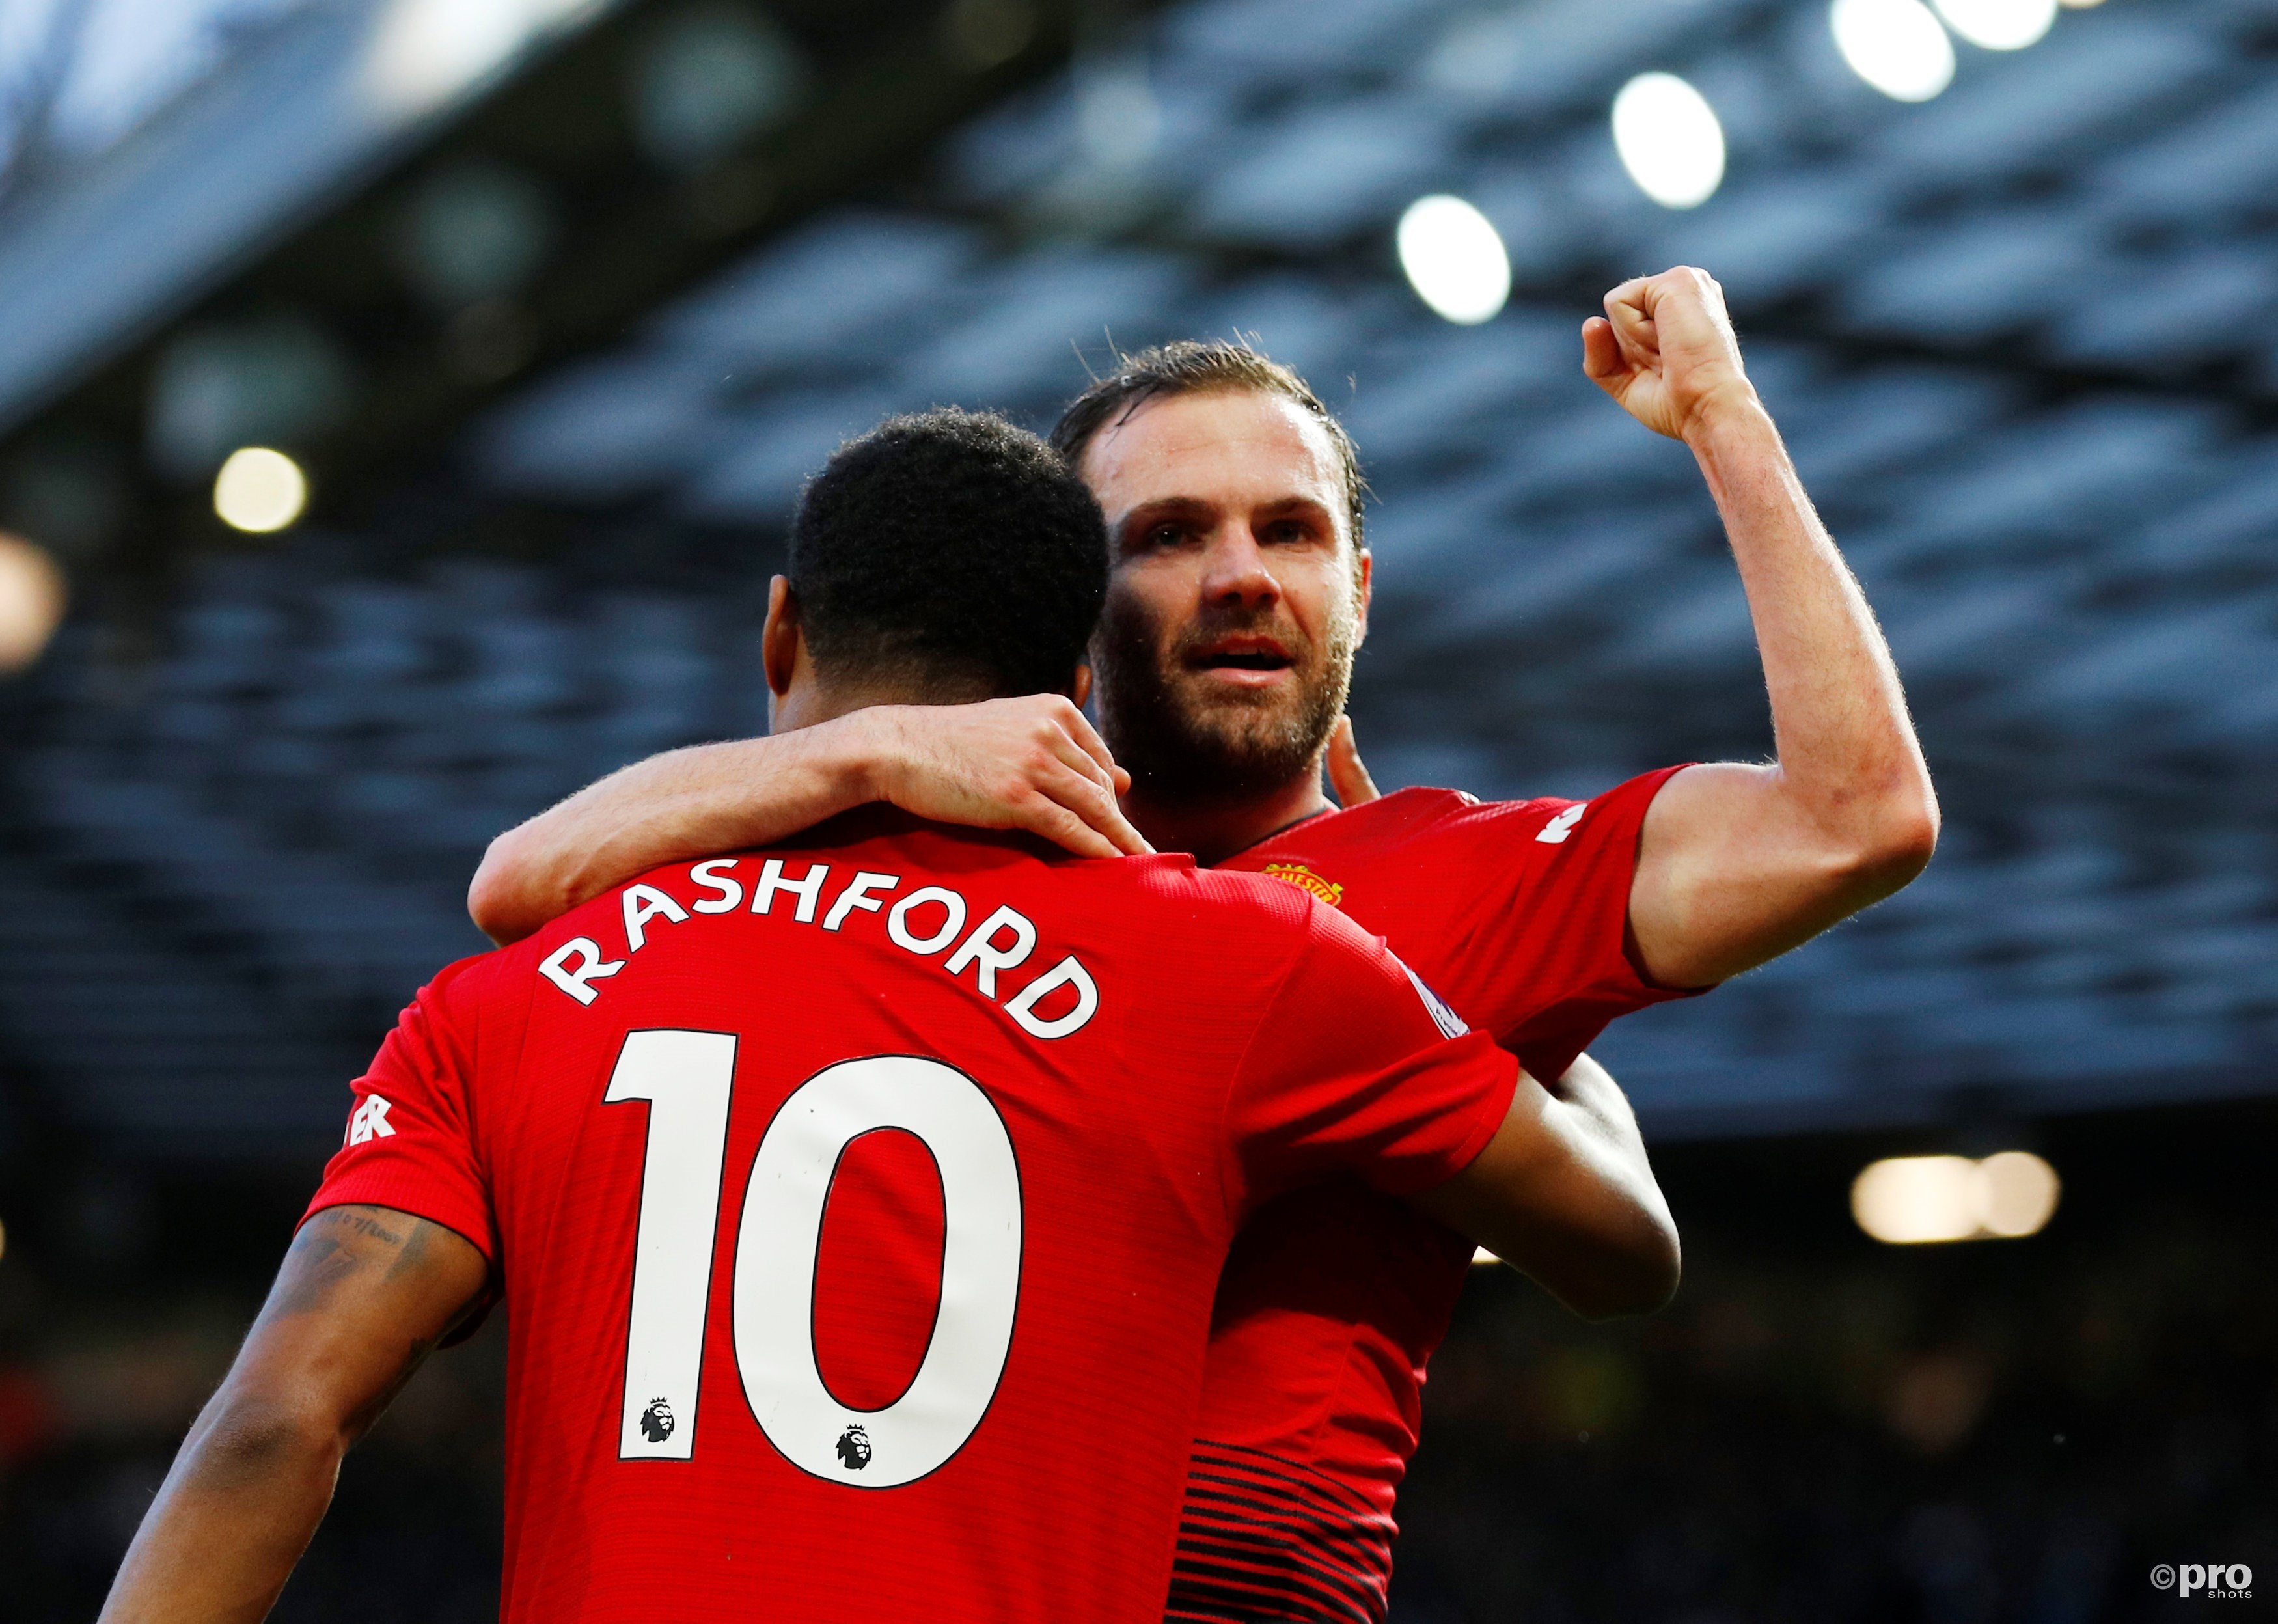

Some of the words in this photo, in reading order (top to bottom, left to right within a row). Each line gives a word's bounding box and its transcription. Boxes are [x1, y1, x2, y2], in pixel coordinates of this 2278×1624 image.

[538, 858, 1099, 1039] RASHFORD
[343, 1094, 396, 1147] ER
[602, 1027, 1022, 1489] 10
